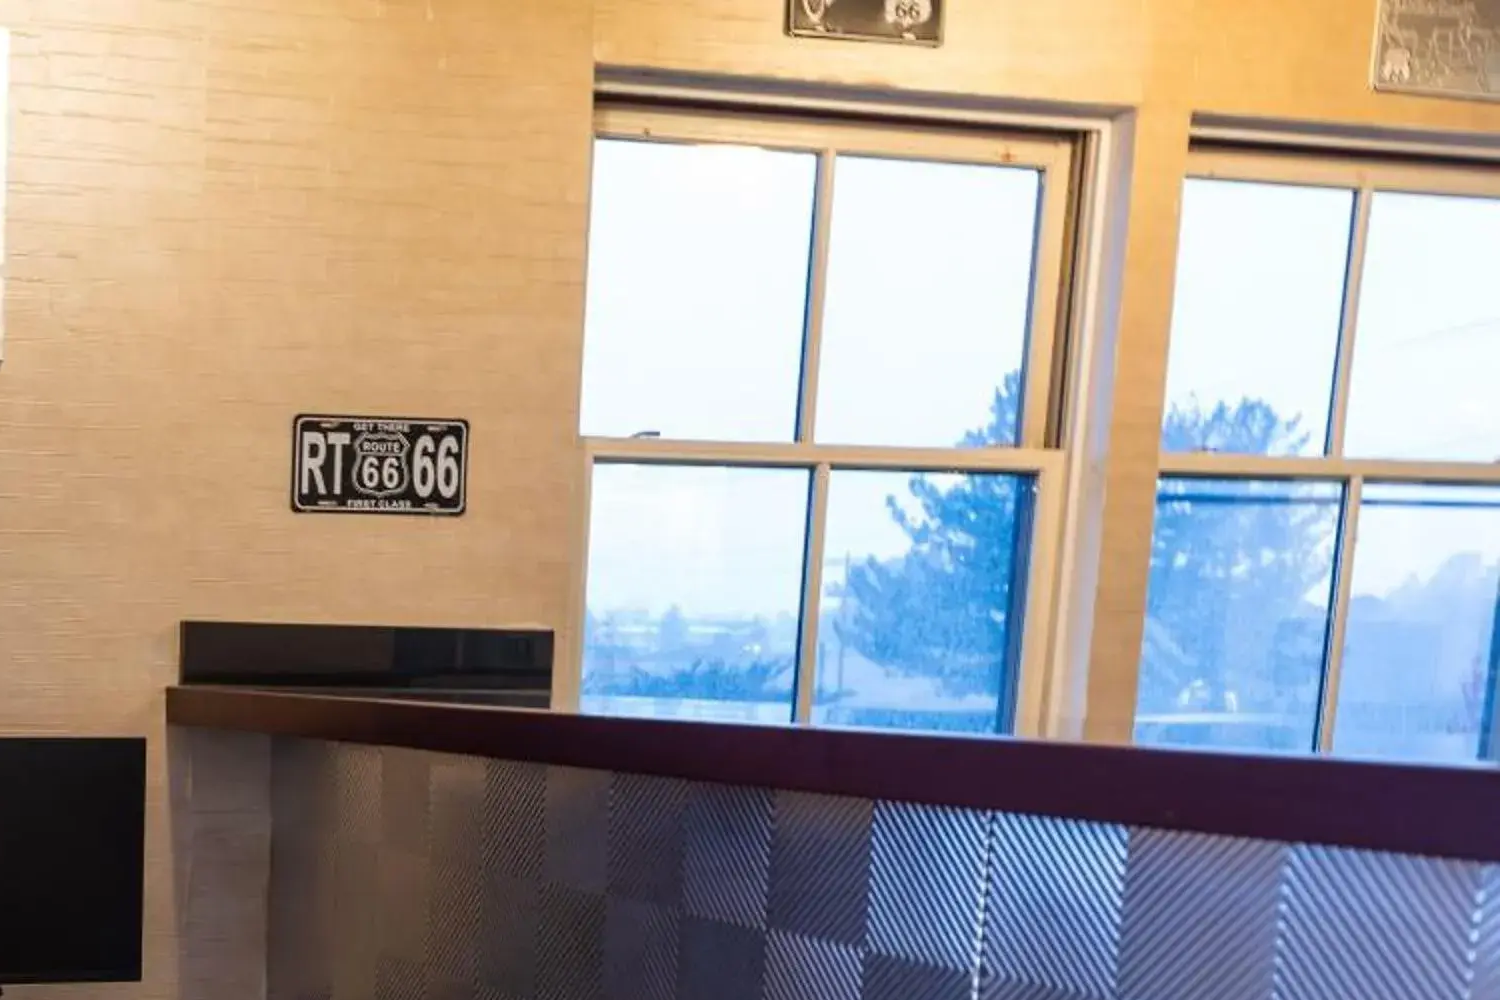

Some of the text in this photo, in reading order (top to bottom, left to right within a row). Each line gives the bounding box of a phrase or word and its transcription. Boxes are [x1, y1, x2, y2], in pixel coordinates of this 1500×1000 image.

[354, 422, 372, 431] GET
[362, 441, 400, 453] ROUTE
[301, 431, 459, 499] RT 66
[362, 456, 399, 488] 66
